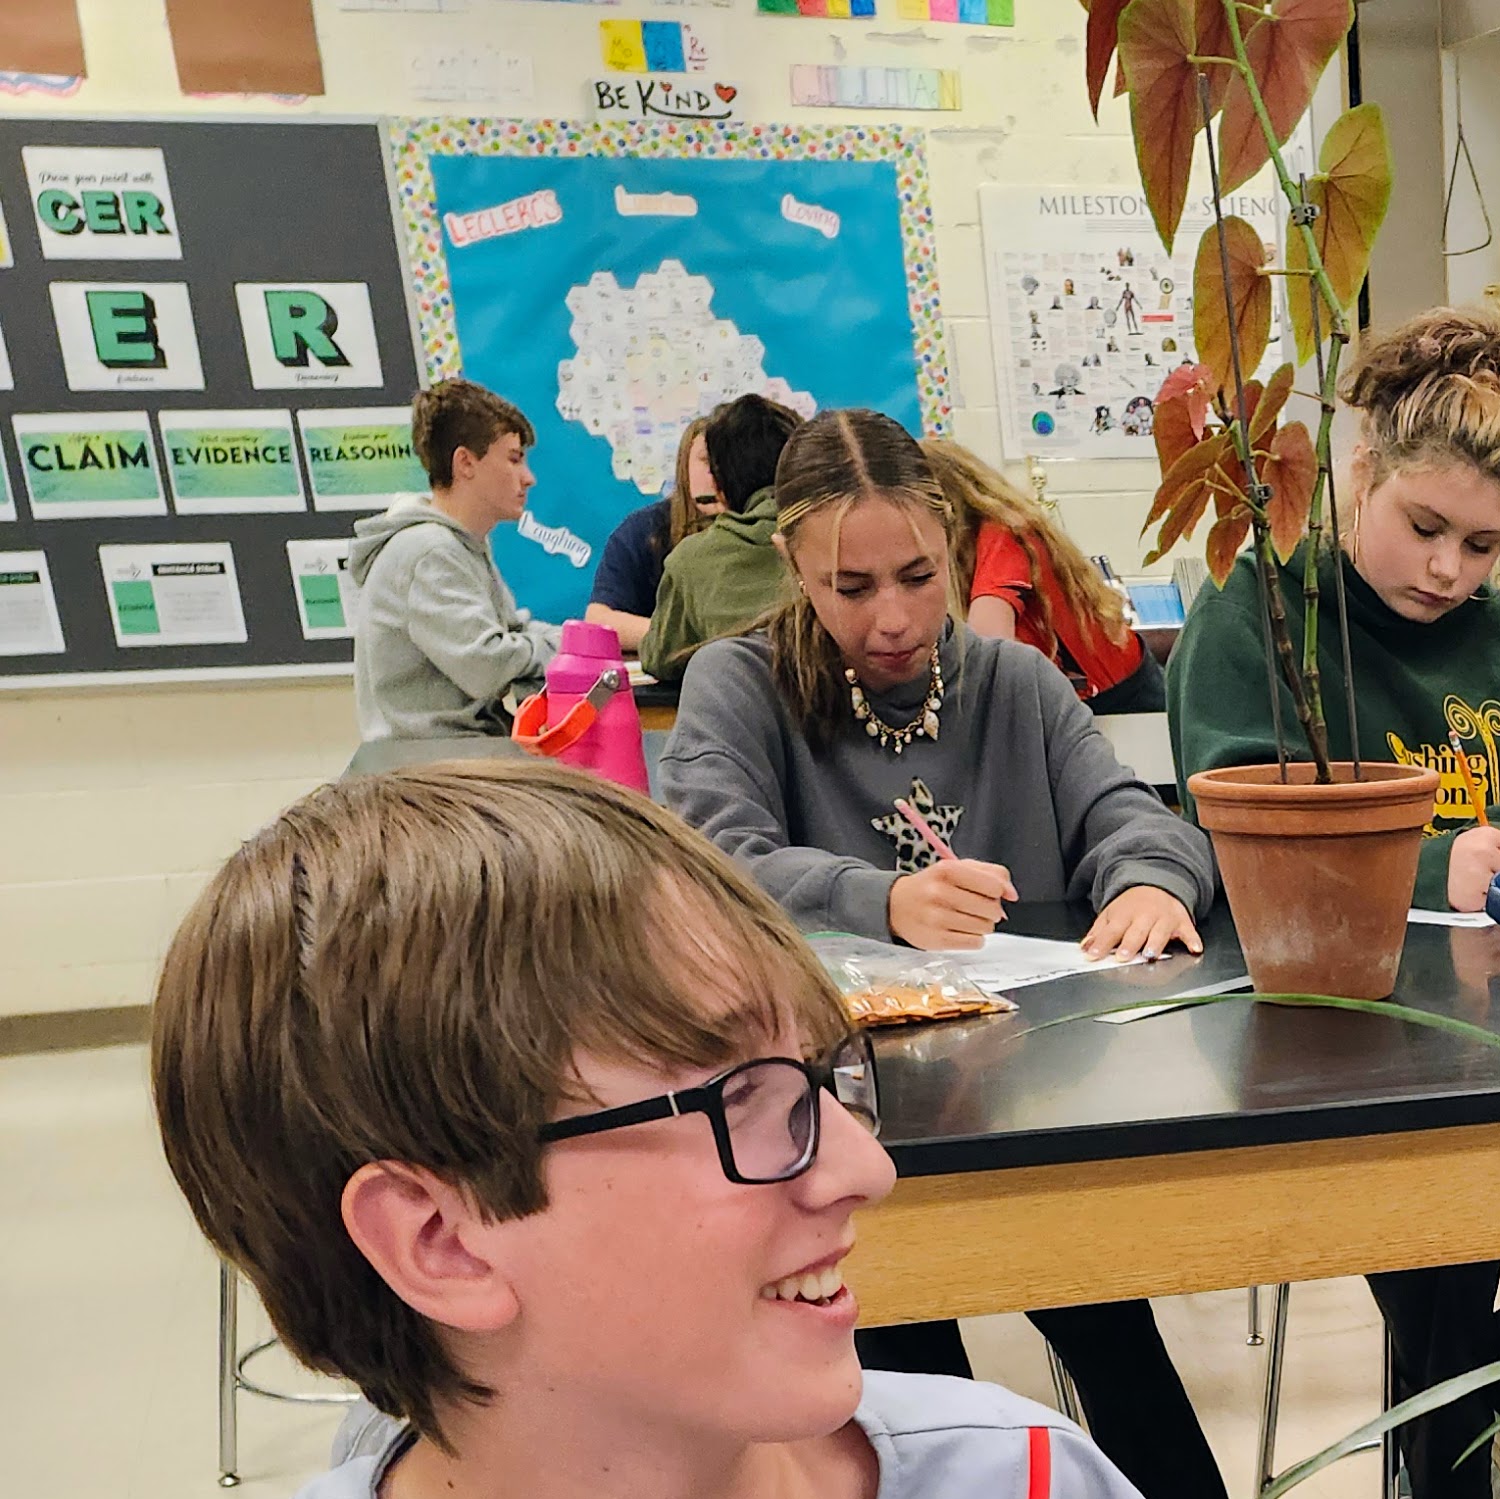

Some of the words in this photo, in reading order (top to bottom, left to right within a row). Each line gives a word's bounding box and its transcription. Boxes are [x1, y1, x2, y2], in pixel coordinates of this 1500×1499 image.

[595, 81, 630, 109] BE
[37, 188, 172, 235] CER
[449, 193, 562, 245] LECLERCS
[85, 291, 168, 369] E
[263, 290, 352, 367] R
[28, 442, 149, 471] CLAIM
[172, 443, 291, 465] EVIDENCE
[310, 444, 412, 463] REASONIN
